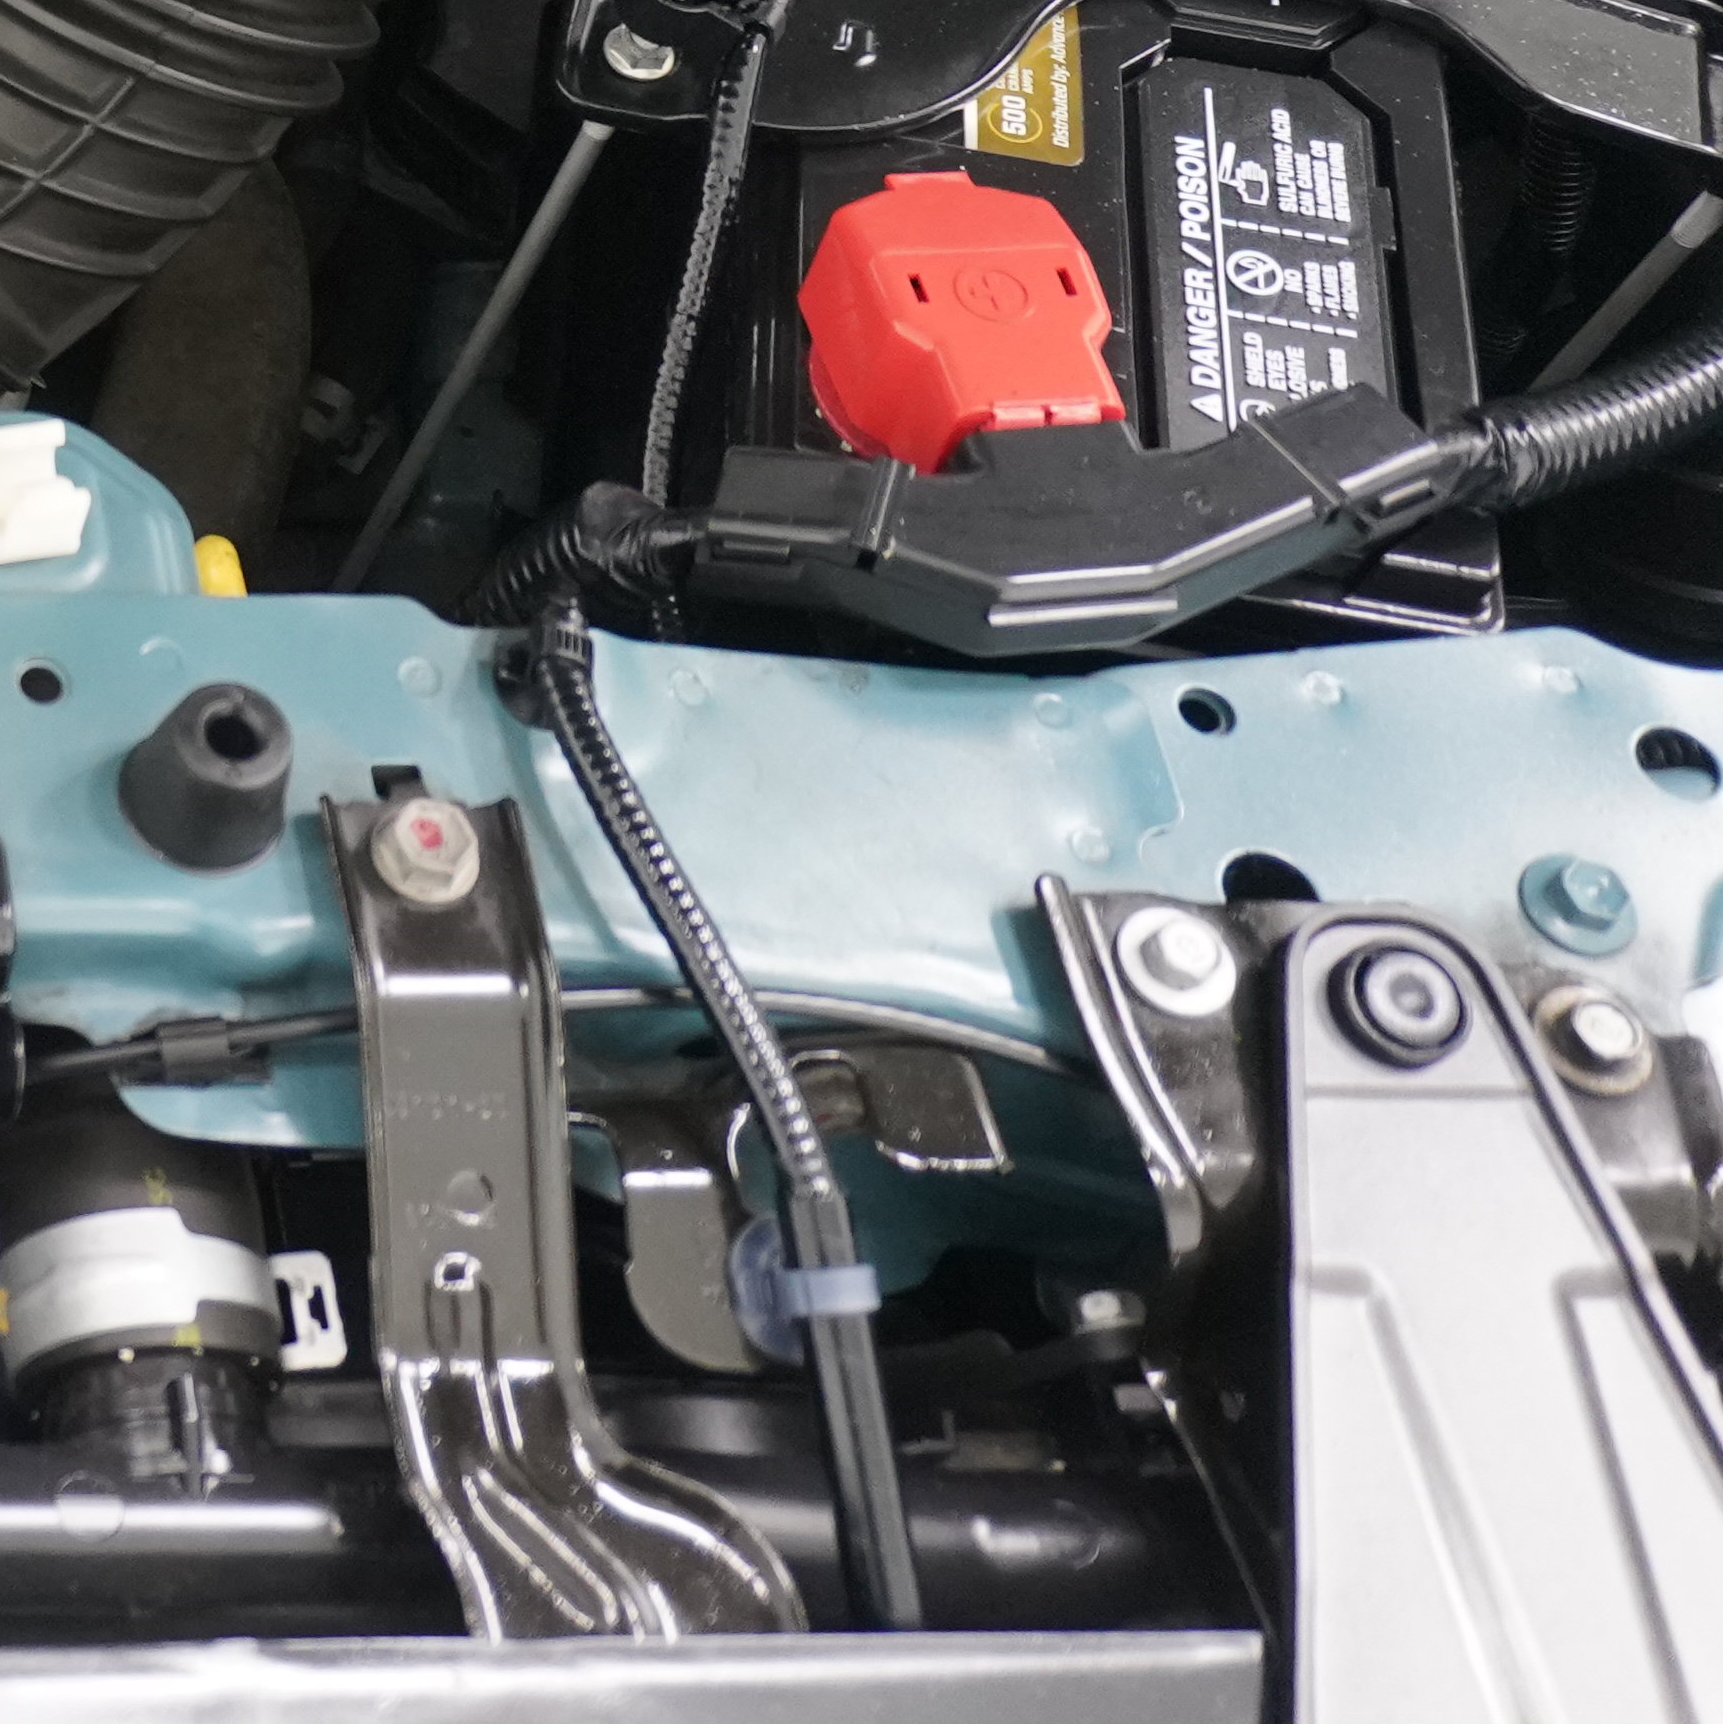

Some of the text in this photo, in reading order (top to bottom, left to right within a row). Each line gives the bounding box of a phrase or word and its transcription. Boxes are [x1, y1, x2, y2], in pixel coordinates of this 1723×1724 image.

[1050, 17, 1066, 62] Advance
[1022, 68, 1034, 94] AMPS
[1001, 95, 1027, 135] 500
[1049, 84, 1069, 148] Distributed
[1175, 135, 1211, 241] POISON
[1271, 109, 1298, 212] SULFURIC ACID
[1294, 153, 1316, 216] CAN CAUSE
[1284, 268, 1303, 293] NO
[1184, 267, 1221, 389] DANGER
[1243, 332, 1265, 387] SHIELD
[1265, 349, 1288, 391] EYES
